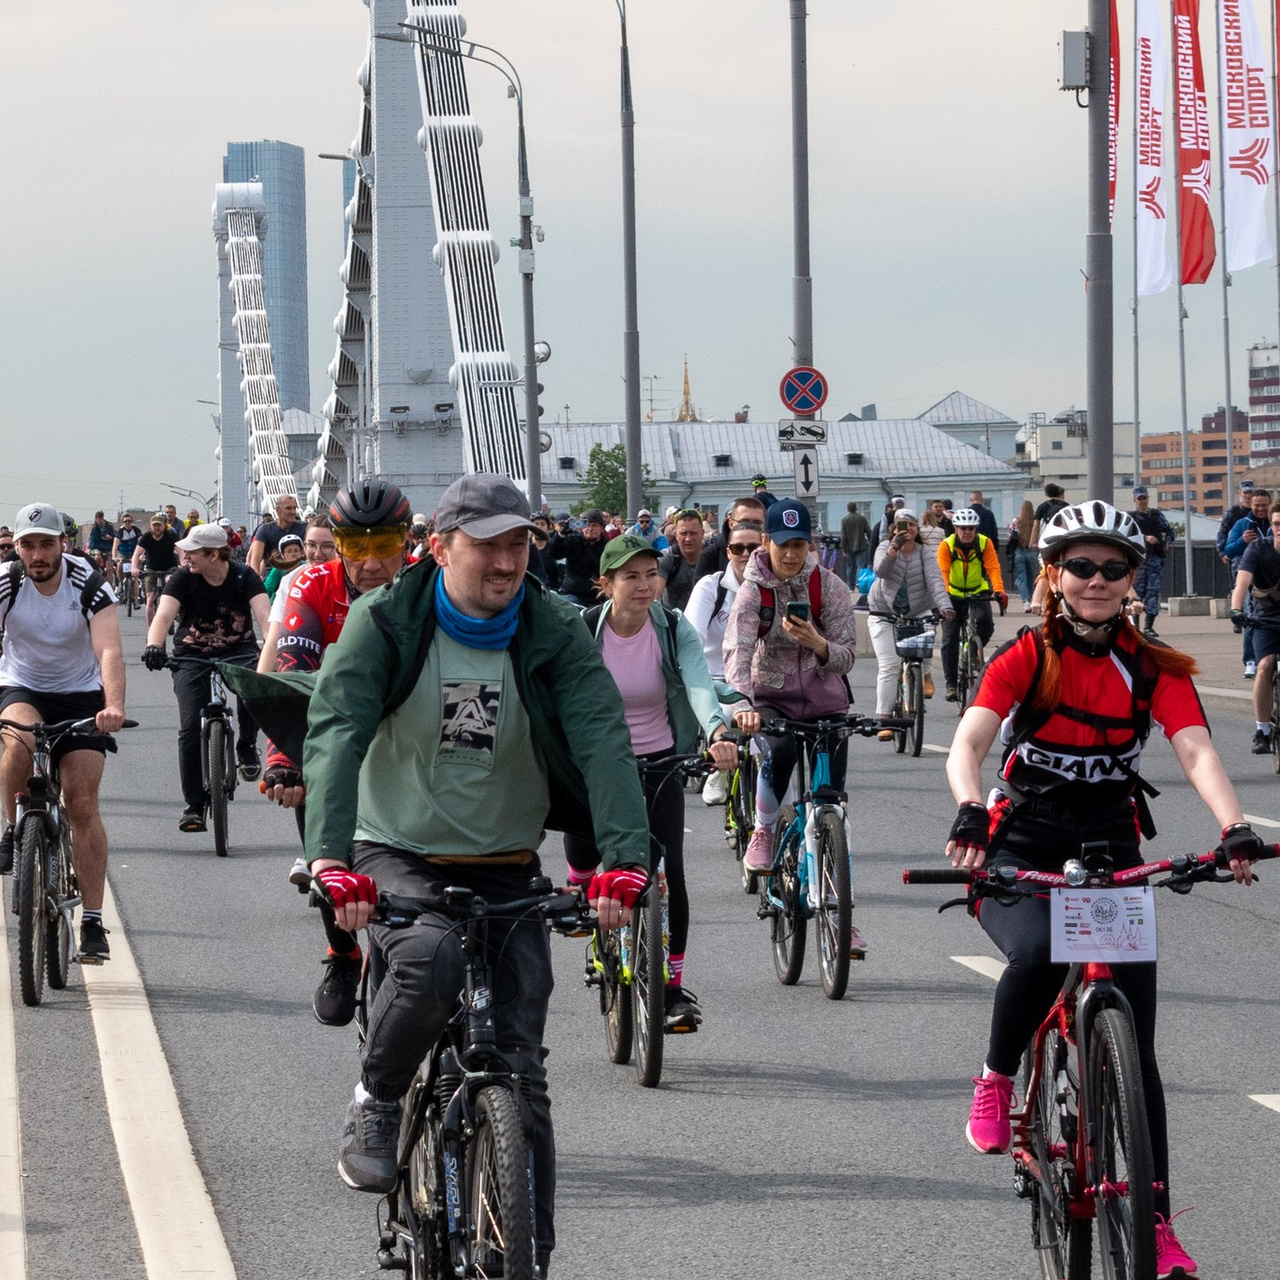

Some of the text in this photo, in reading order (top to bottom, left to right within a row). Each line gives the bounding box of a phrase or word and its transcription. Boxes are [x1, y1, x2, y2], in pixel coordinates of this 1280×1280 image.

[1138, 37, 1152, 166] МОСКОВСКИЙ
[1174, 15, 1197, 150] МОСКОВСКИЙ
[1246, 64, 1270, 129] СПОРТ
[1150, 107, 1162, 168] СПОРТ
[1195, 87, 1210, 151] СПОРТ
[1026, 747, 1139, 779] GIANT
